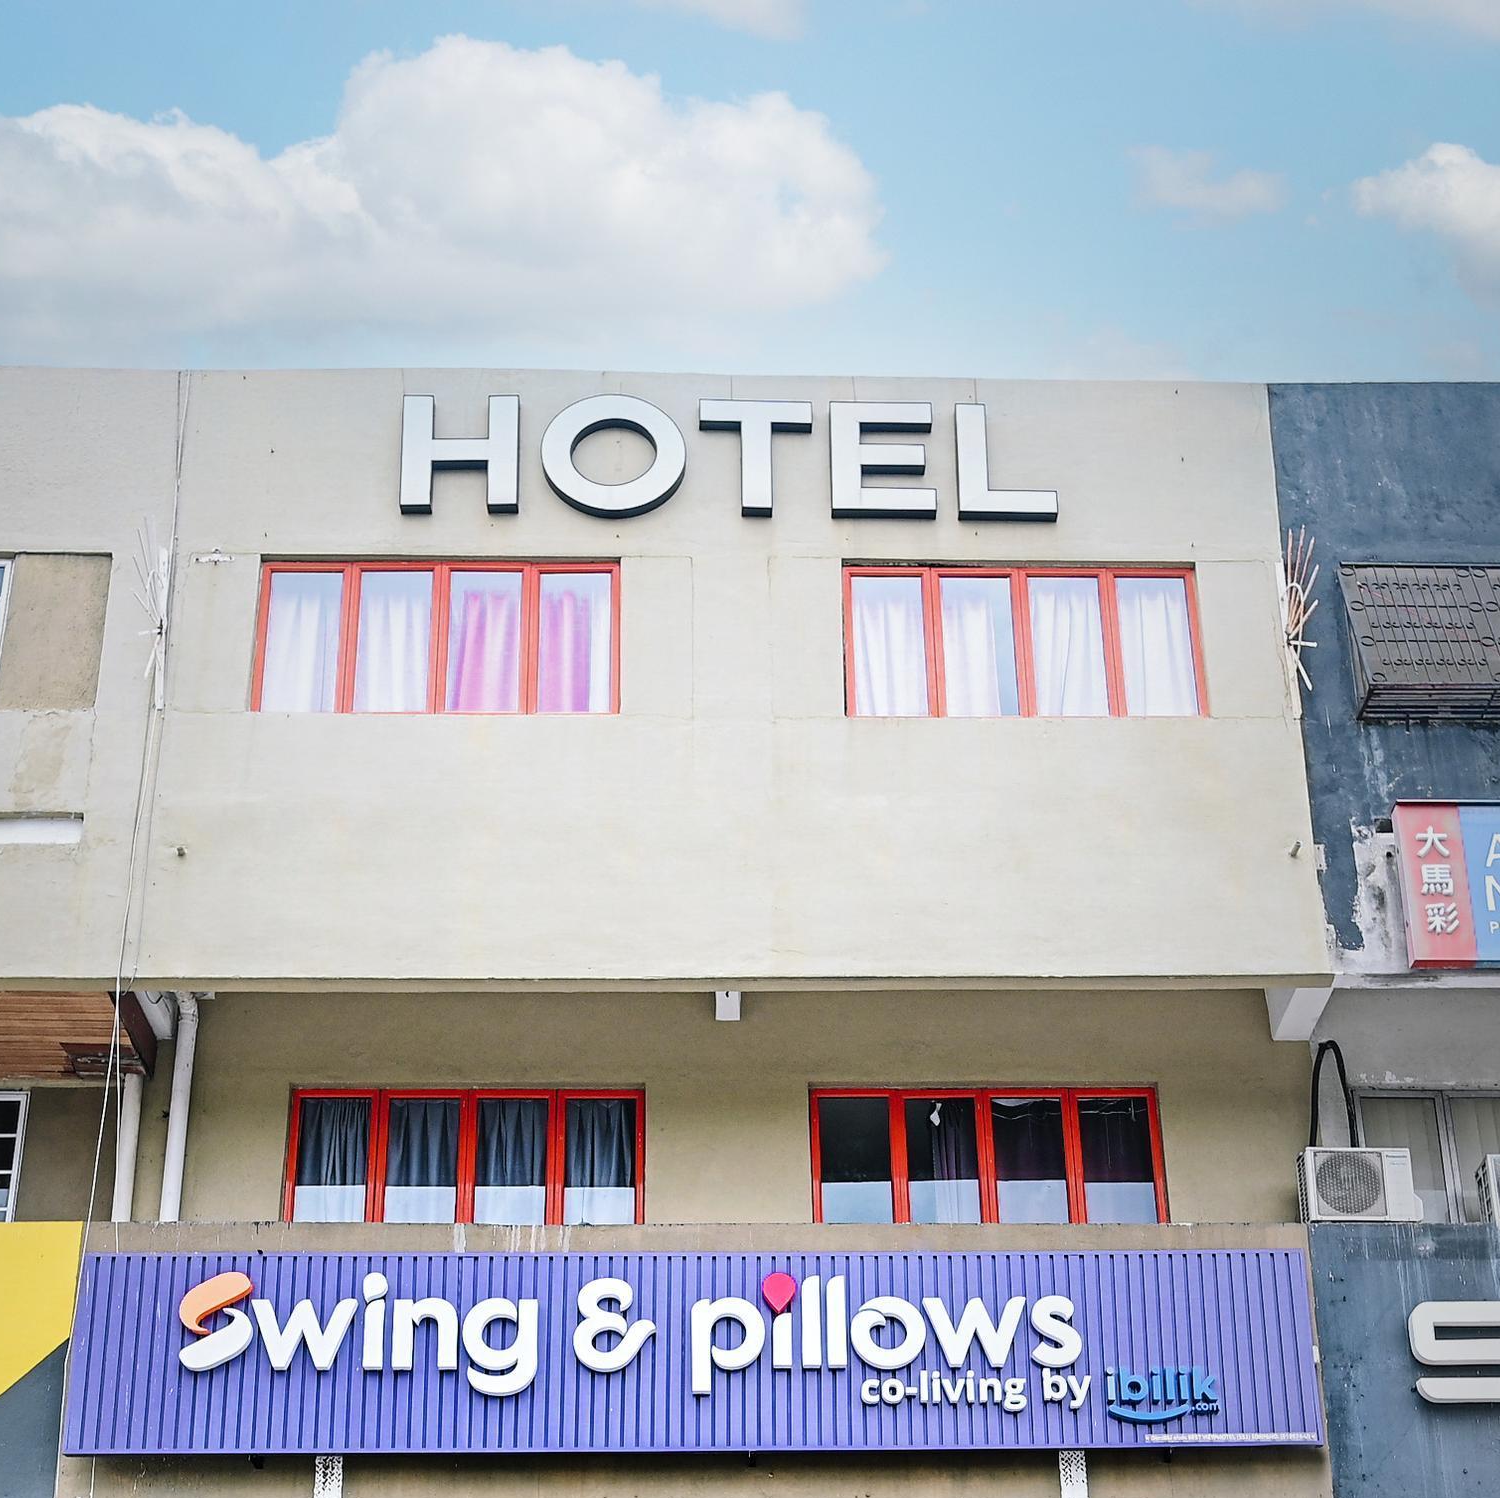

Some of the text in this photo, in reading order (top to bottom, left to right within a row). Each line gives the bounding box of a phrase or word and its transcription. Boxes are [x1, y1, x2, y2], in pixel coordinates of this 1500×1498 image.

[400, 393, 1058, 523] HOTEL
[1416, 825, 1461, 936] 大馬彩
[178, 1271, 1083, 1397] Swing & pillows
[860, 1370, 1028, 1413] co-living
[1042, 1367, 1092, 1411] by
